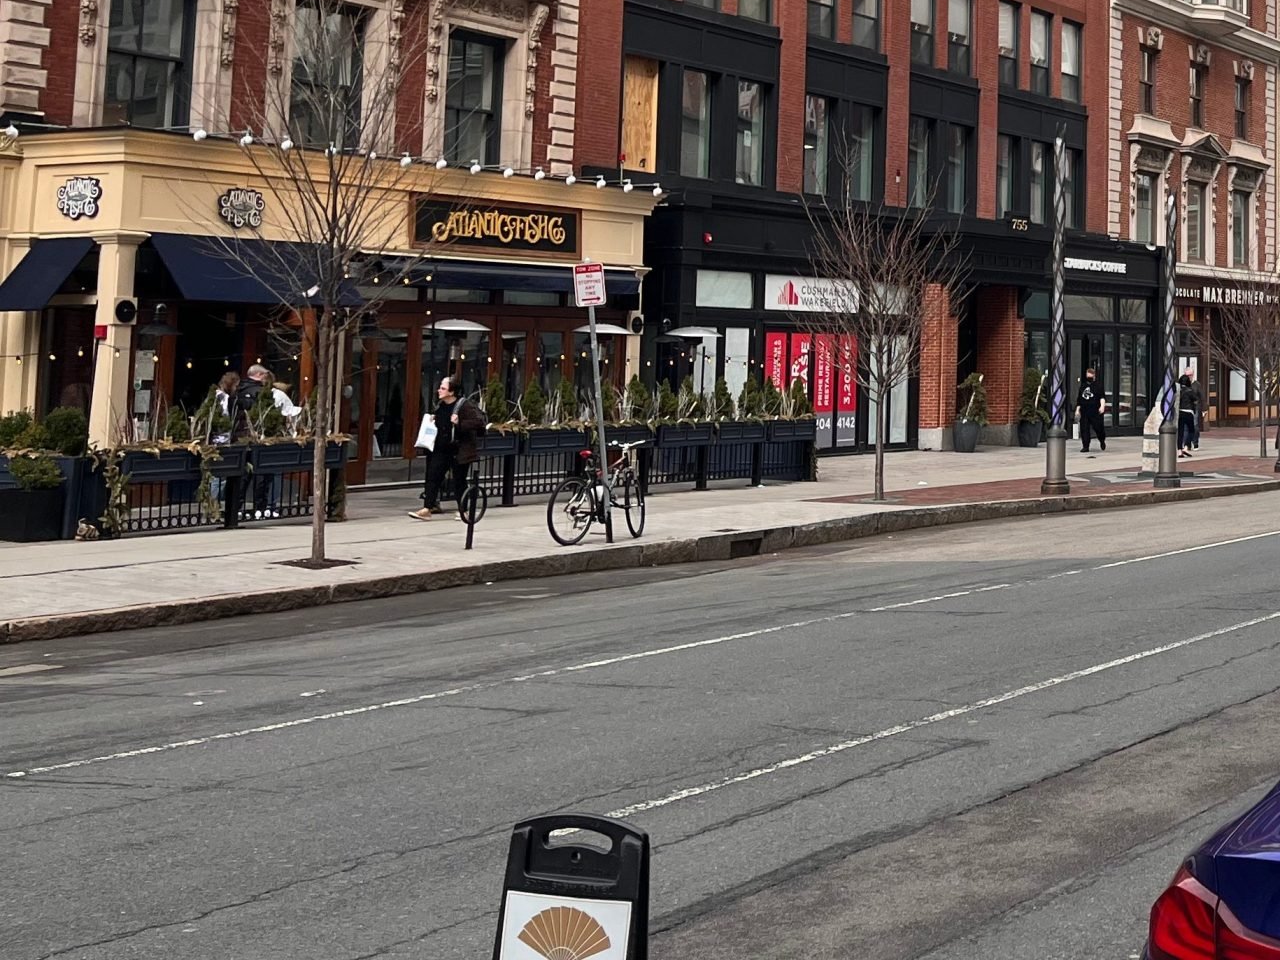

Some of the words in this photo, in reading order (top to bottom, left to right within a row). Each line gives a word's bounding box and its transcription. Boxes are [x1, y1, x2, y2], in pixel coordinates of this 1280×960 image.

[432, 210, 514, 243] ATLANTIC
[509, 214, 549, 243] FISH
[1012, 218, 1028, 231] 755
[1102, 261, 1126, 273] COFFEE
[1203, 286, 1223, 303] MAX
[837, 416, 855, 428] 4142
